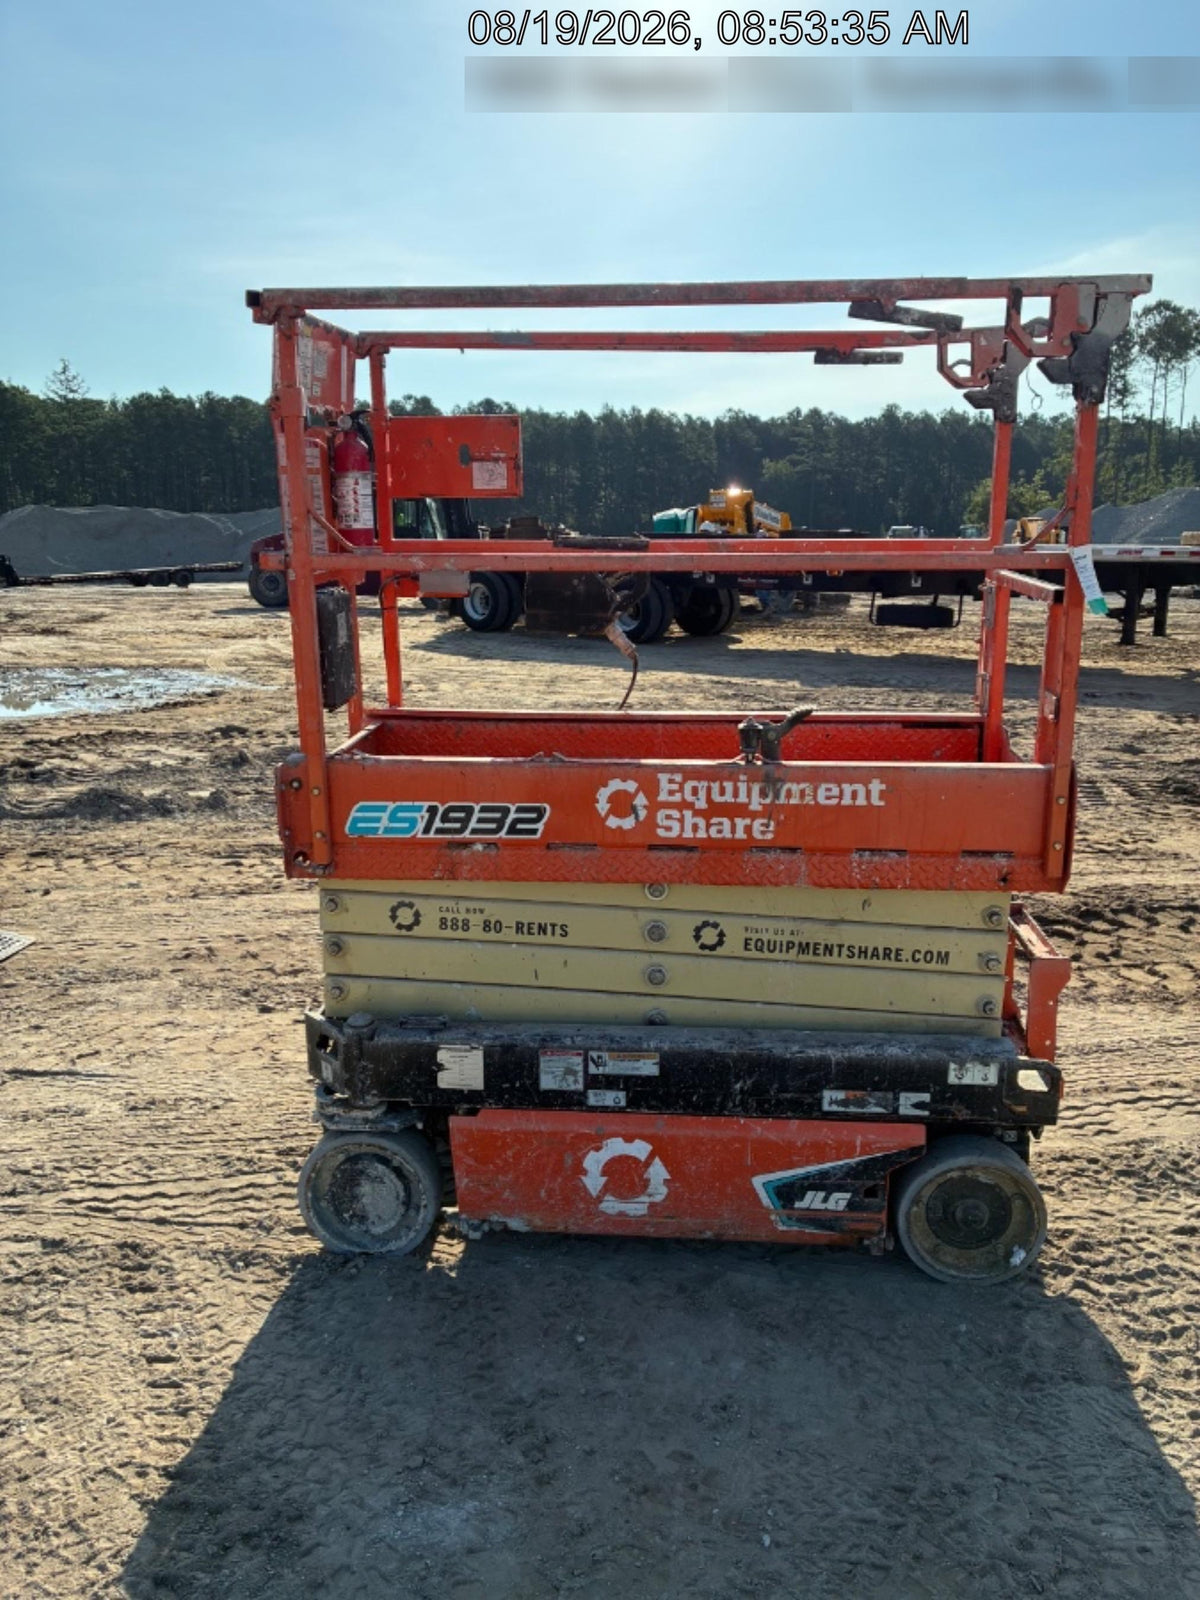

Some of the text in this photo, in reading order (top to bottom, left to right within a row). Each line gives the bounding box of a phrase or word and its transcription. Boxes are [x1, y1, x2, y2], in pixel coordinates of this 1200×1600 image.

[656, 772, 887, 811] Equipment
[346, 801, 550, 839] ES1932
[656, 808, 775, 840] Share
[438, 906, 485, 915] CALL NOW
[439, 917, 569, 937] 888-80-RENTS
[773, 928, 785, 936] US
[743, 937, 950, 966] EQUIPMENTSHARE.COM
[794, 1190, 852, 1212] JLG
